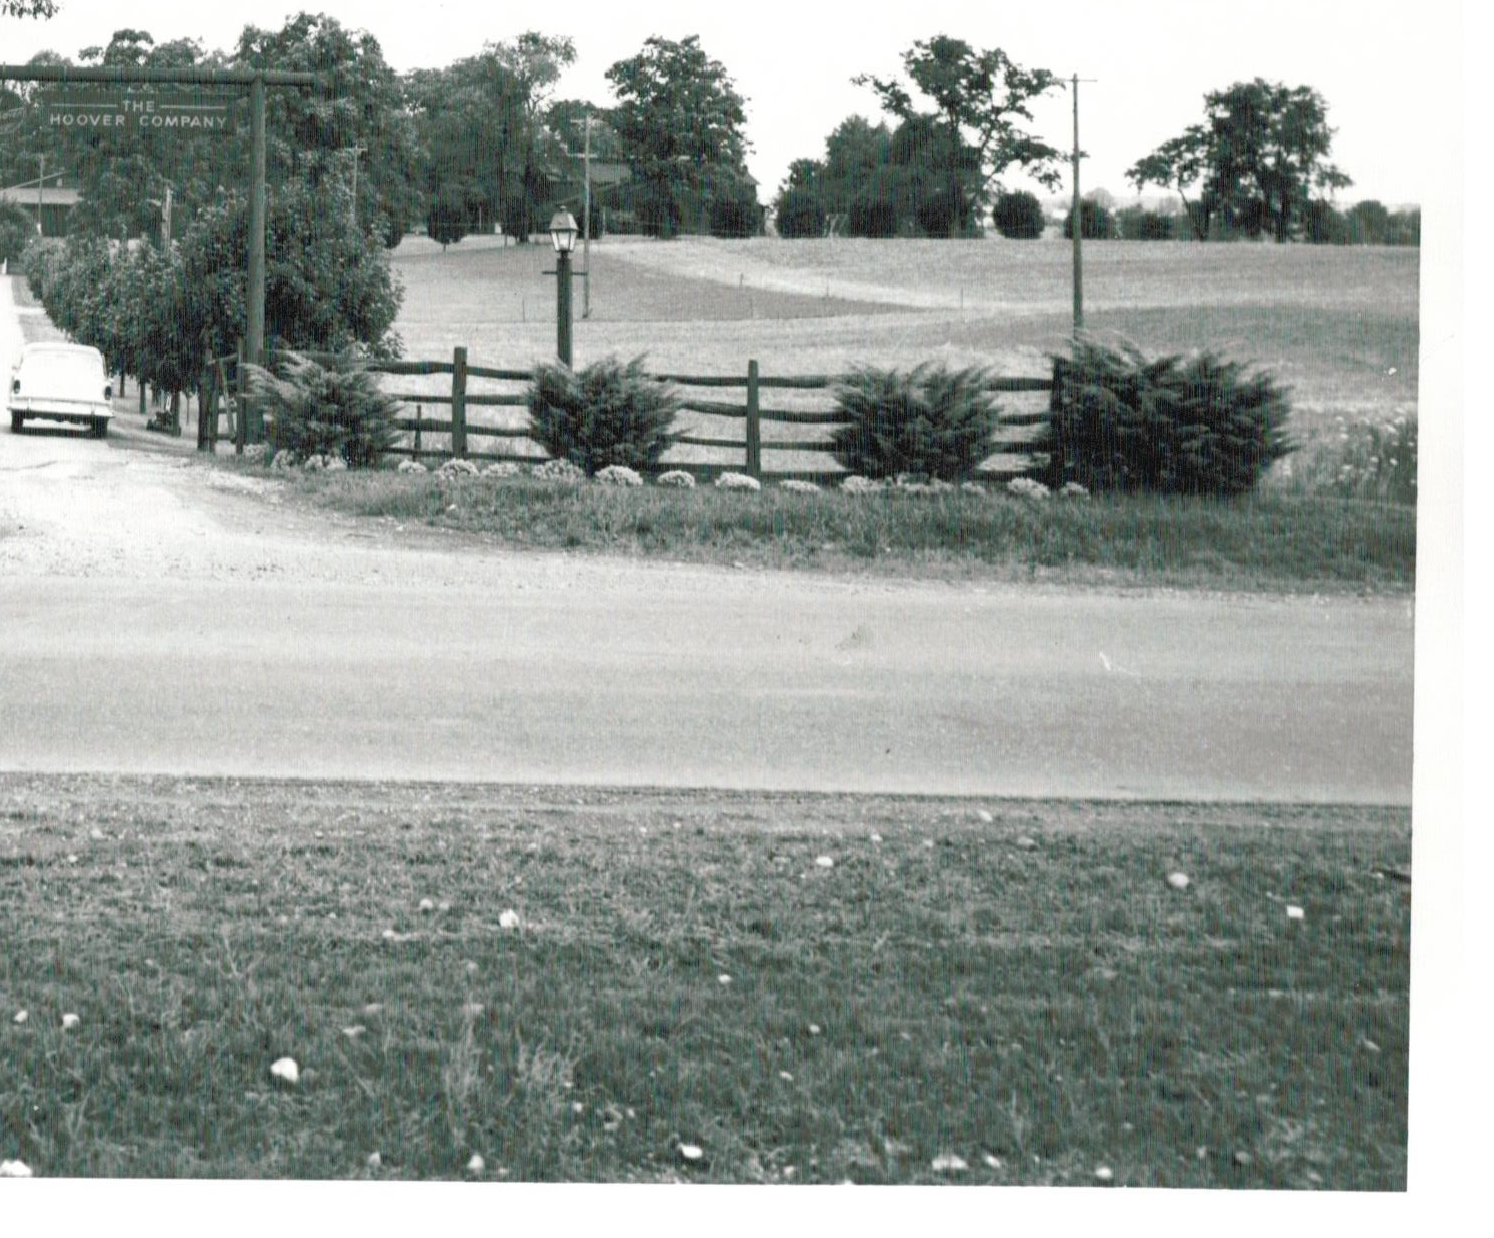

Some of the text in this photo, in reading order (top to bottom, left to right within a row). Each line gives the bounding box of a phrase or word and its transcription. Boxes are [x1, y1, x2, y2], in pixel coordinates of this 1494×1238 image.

[122, 99, 156, 113] THE
[49, 113, 228, 129] HOOVER COMPANY
